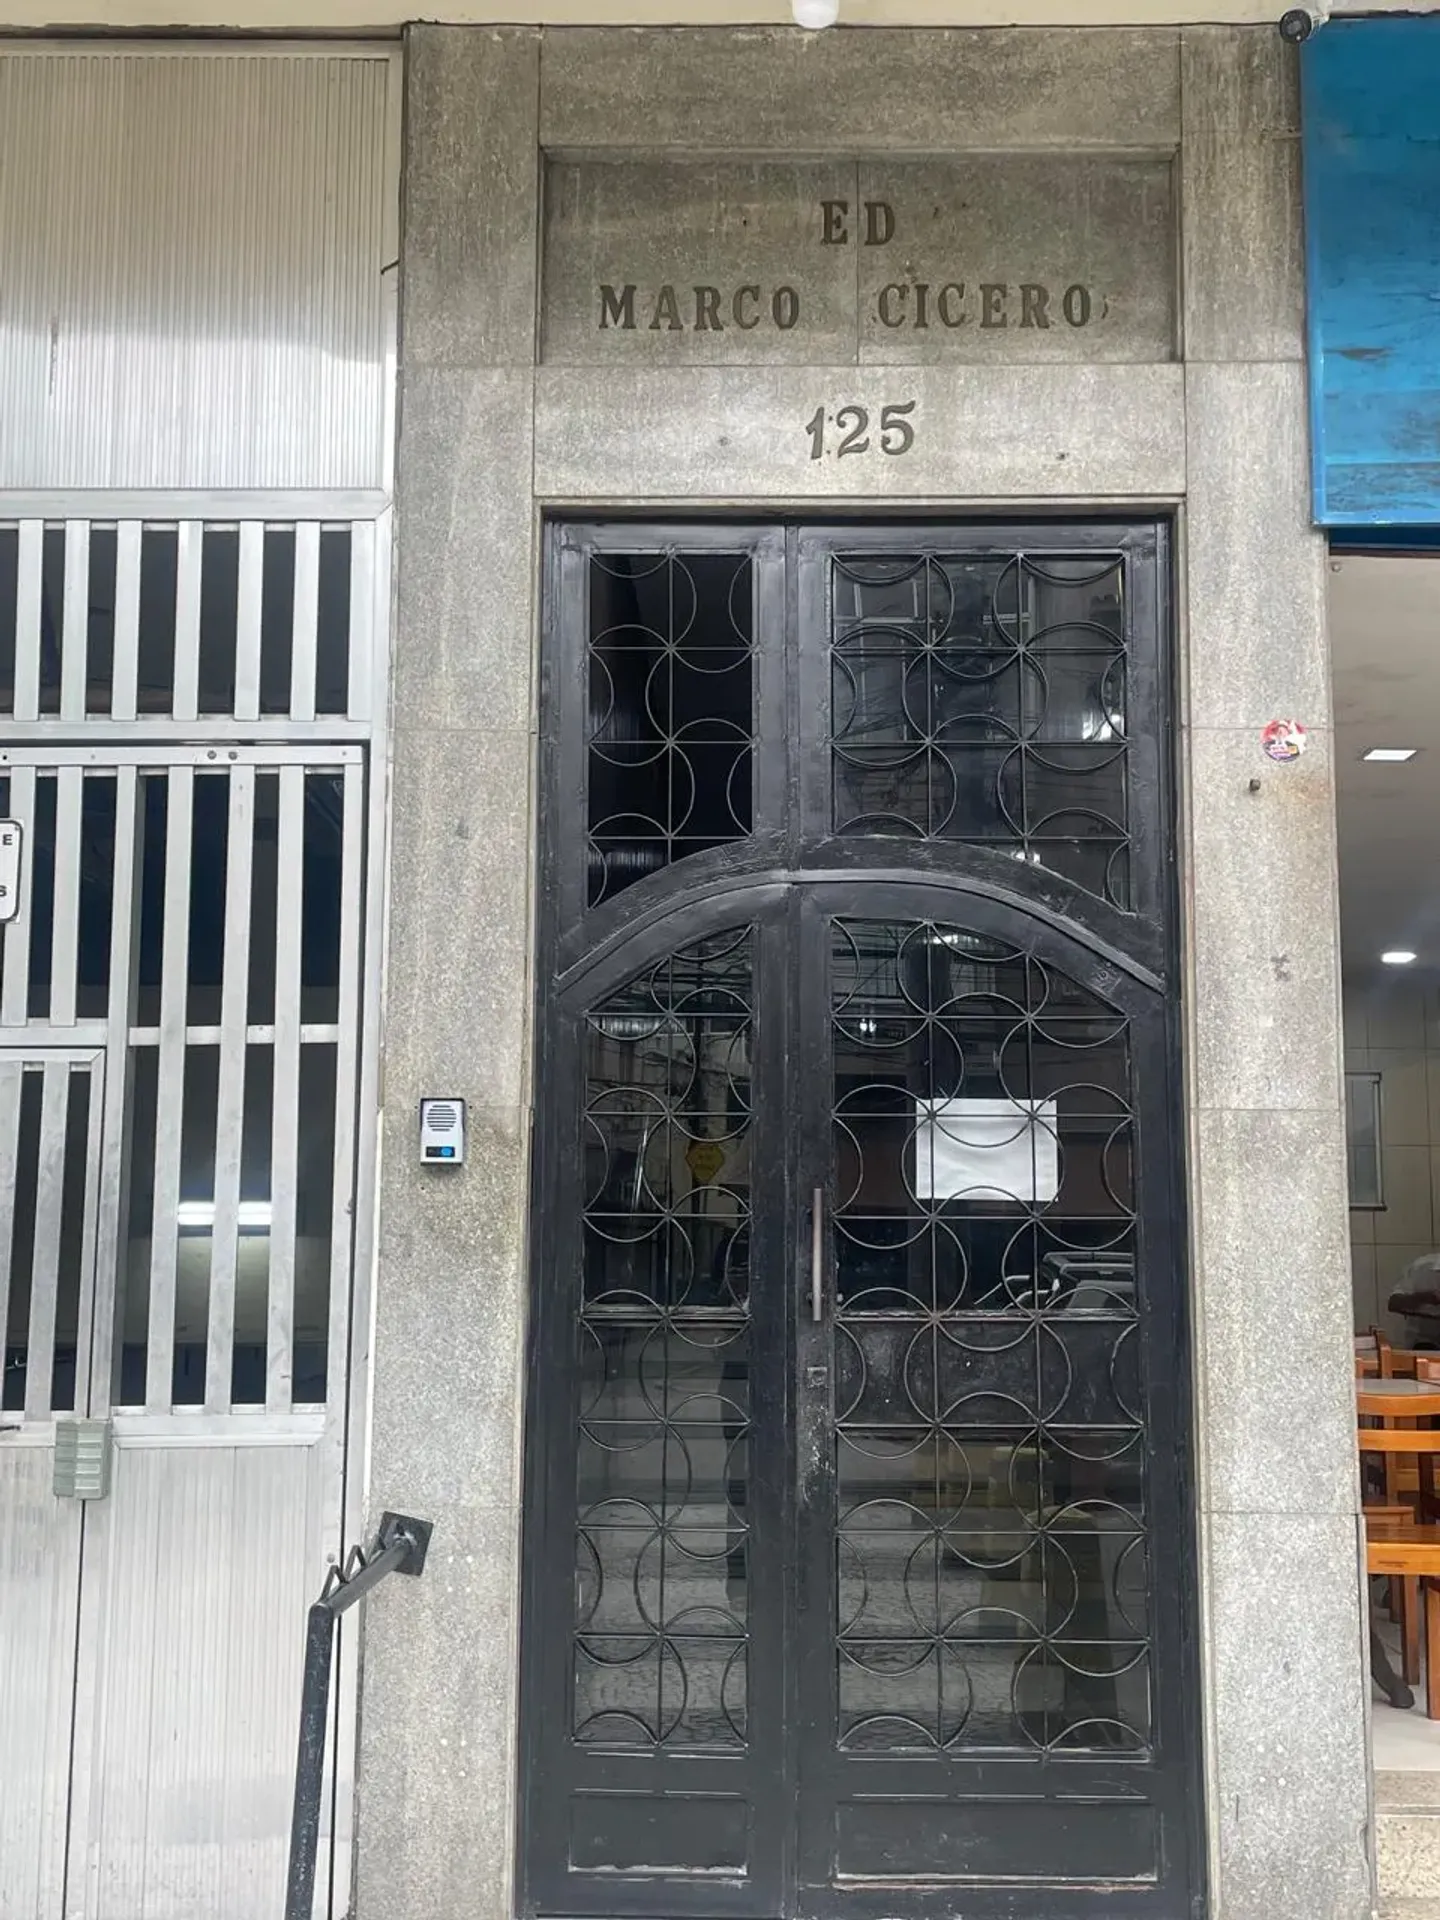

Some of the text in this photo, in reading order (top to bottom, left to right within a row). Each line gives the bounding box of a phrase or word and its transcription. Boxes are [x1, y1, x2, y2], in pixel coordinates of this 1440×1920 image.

[820, 201, 895, 246] ED
[599, 283, 1092, 331] MARCO CICERO
[805, 401, 916, 460] 125
